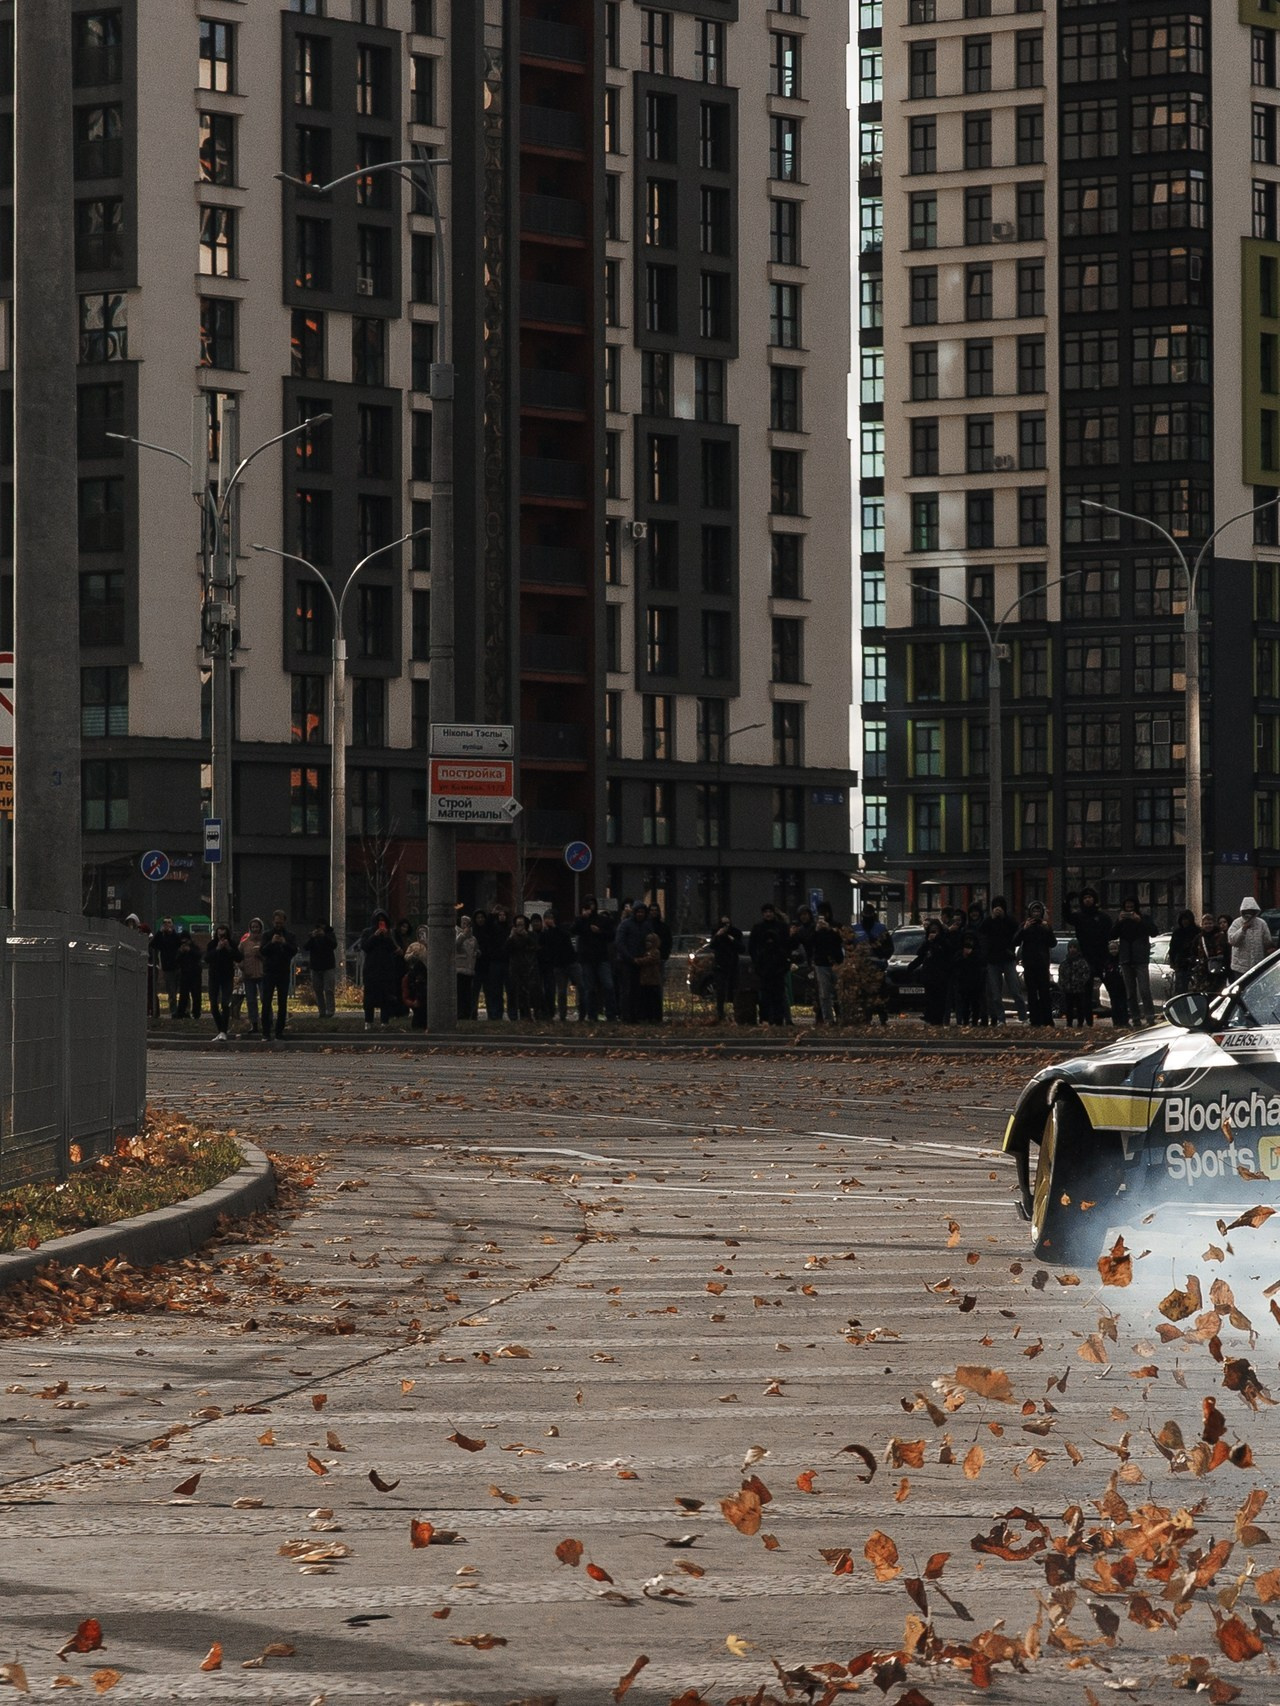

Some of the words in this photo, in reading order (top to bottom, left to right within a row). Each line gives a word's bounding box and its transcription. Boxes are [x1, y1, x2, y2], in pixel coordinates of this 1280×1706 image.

[475, 730, 502, 738] Тэслы
[441, 767, 502, 779] постройка
[437, 797, 472, 809] Строй
[437, 809, 502, 820] материалы
[1222, 1033, 1264, 1048] ALEKSEY
[1166, 1142, 1256, 1186] Sports
